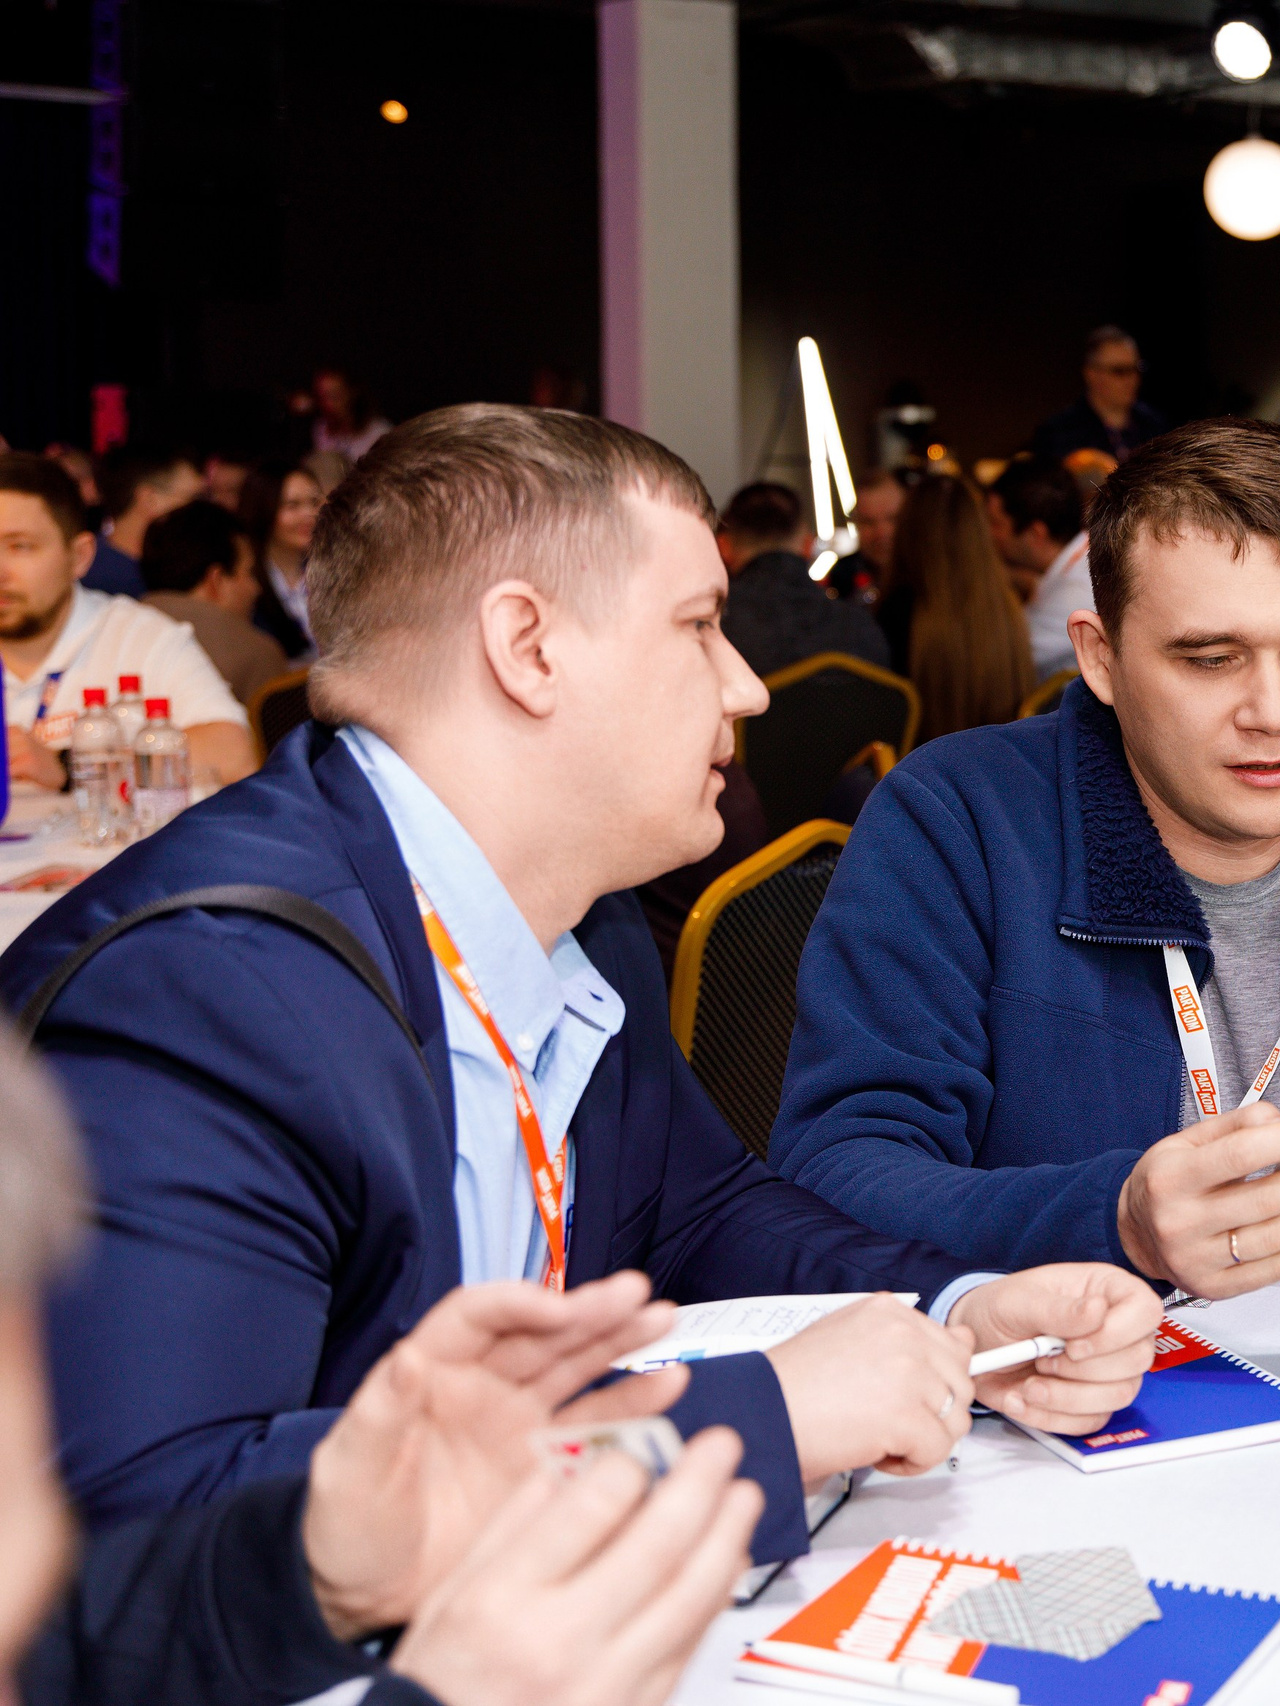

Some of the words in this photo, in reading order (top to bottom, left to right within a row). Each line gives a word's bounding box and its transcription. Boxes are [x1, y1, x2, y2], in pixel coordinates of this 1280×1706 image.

[1175, 986, 1198, 1011] PART
[1180, 1008, 1203, 1033] KOM
[1256, 1067, 1272, 1091] PART
[1264, 1048, 1280, 1072] KOM
[1195, 1070, 1214, 1096] PART
[1199, 1092, 1217, 1115] KOM
